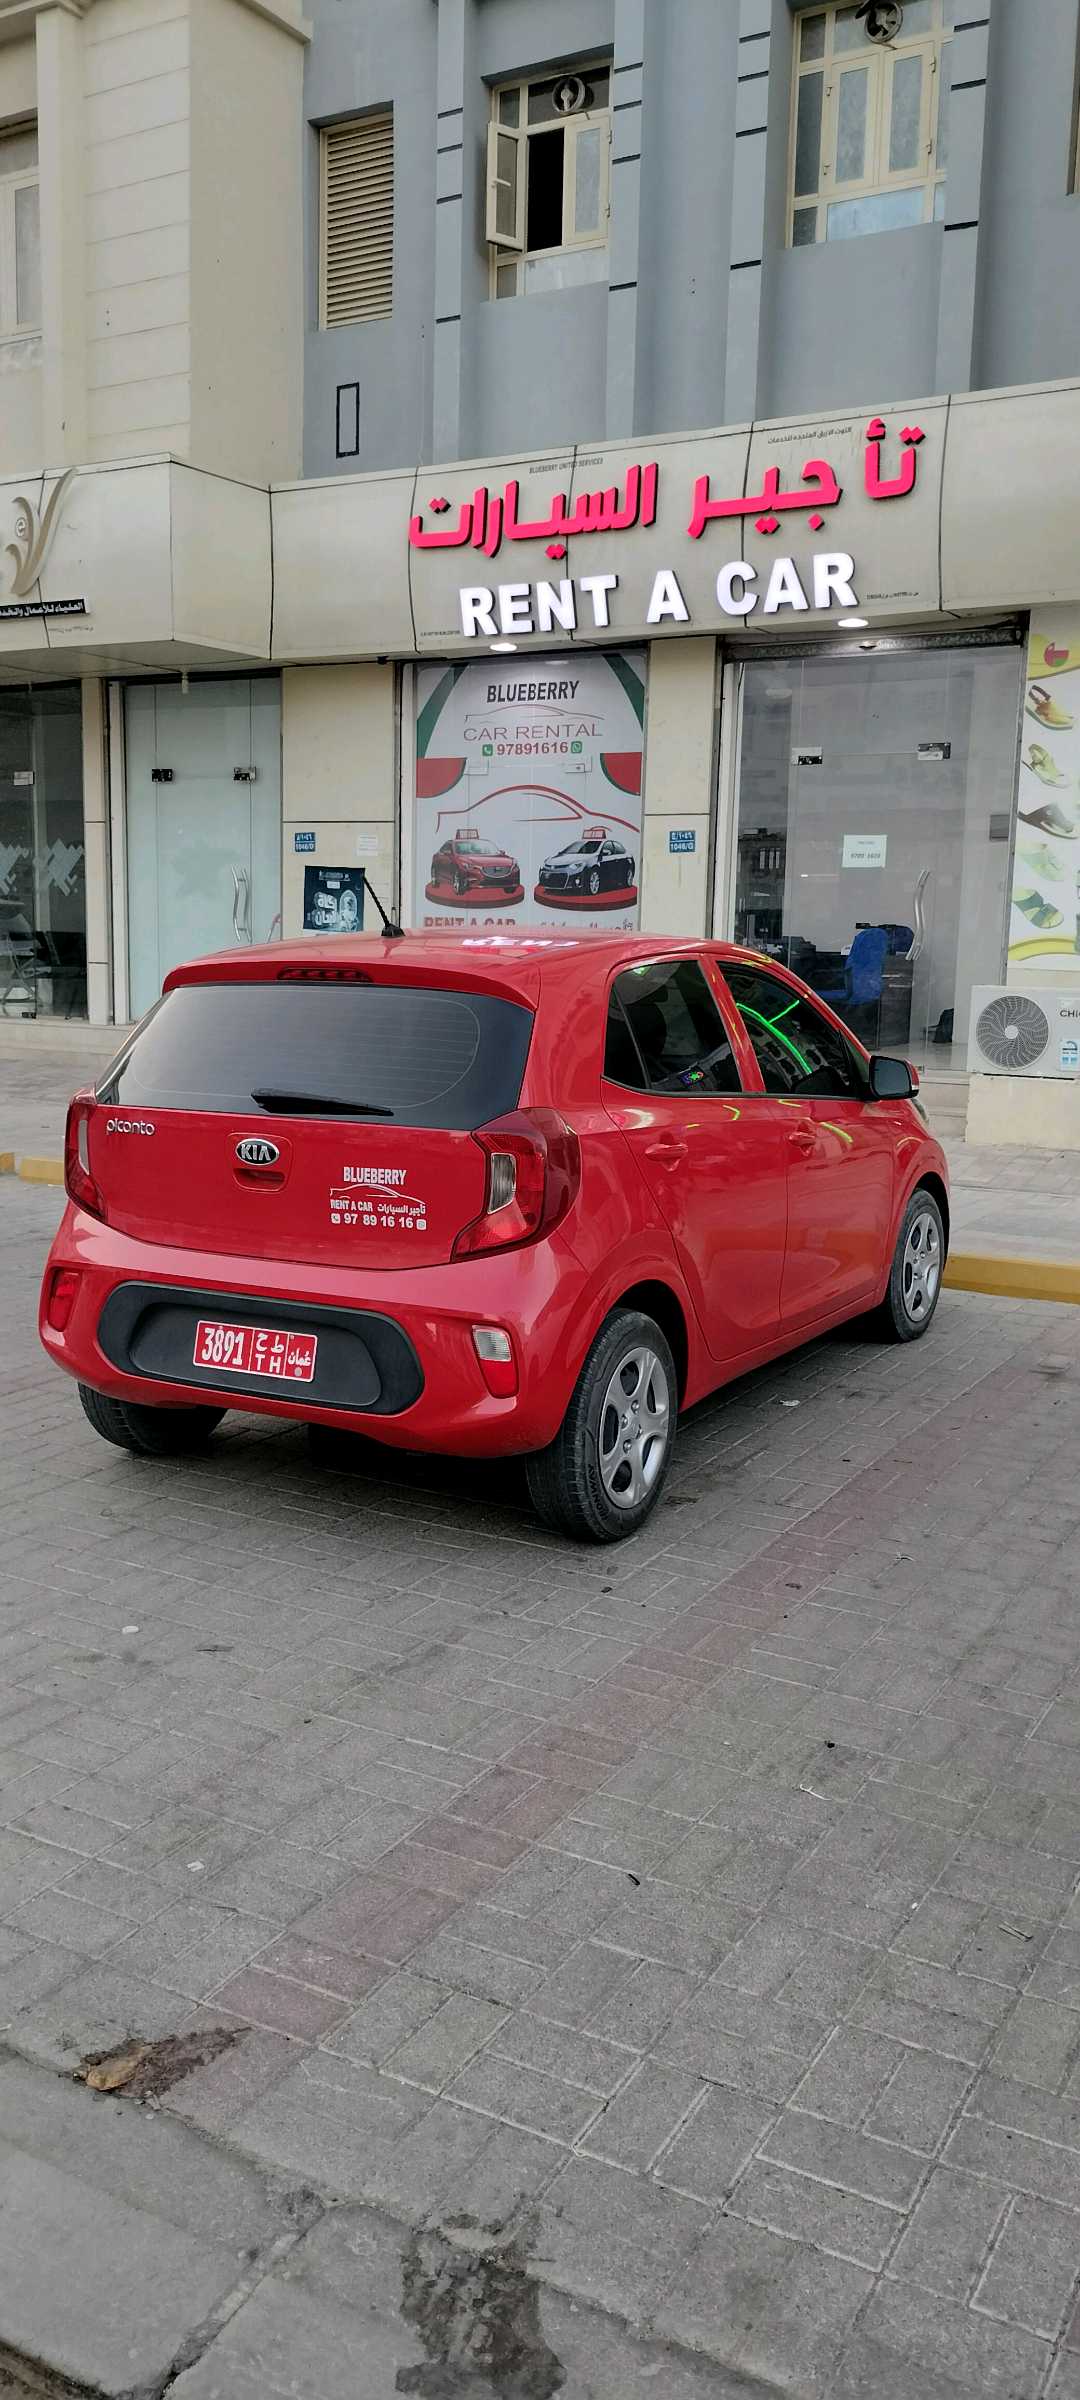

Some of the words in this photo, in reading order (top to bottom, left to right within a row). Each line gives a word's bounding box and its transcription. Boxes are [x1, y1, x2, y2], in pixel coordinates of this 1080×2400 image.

[688, 418, 926, 539] تأجير
[408, 462, 658, 560] السيارات
[459, 574, 618, 637] RENT
[646, 569, 690, 623] A
[716, 552, 859, 616] CAR
[486, 680, 580, 703] BLUEBERRY
[463, 727, 508, 742] CAR
[515, 723, 604, 740] RENTAL
[496, 742, 569, 756] 97891616
[106, 1117, 155, 1136] picanto
[240, 1143, 272, 1161] KIA
[343, 1166, 407, 1185] BLUEBERRY
[330, 1199, 349, 1210] RENT
[350, 1200, 357, 1211] A
[357, 1201, 373, 1213] CAR
[343, 1212, 359, 1225] 97
[362, 1214, 378, 1226] 89
[380, 1215, 396, 1228] 16
[398, 1216, 415, 1229] 16
[201, 1327, 246, 1366] 3891
